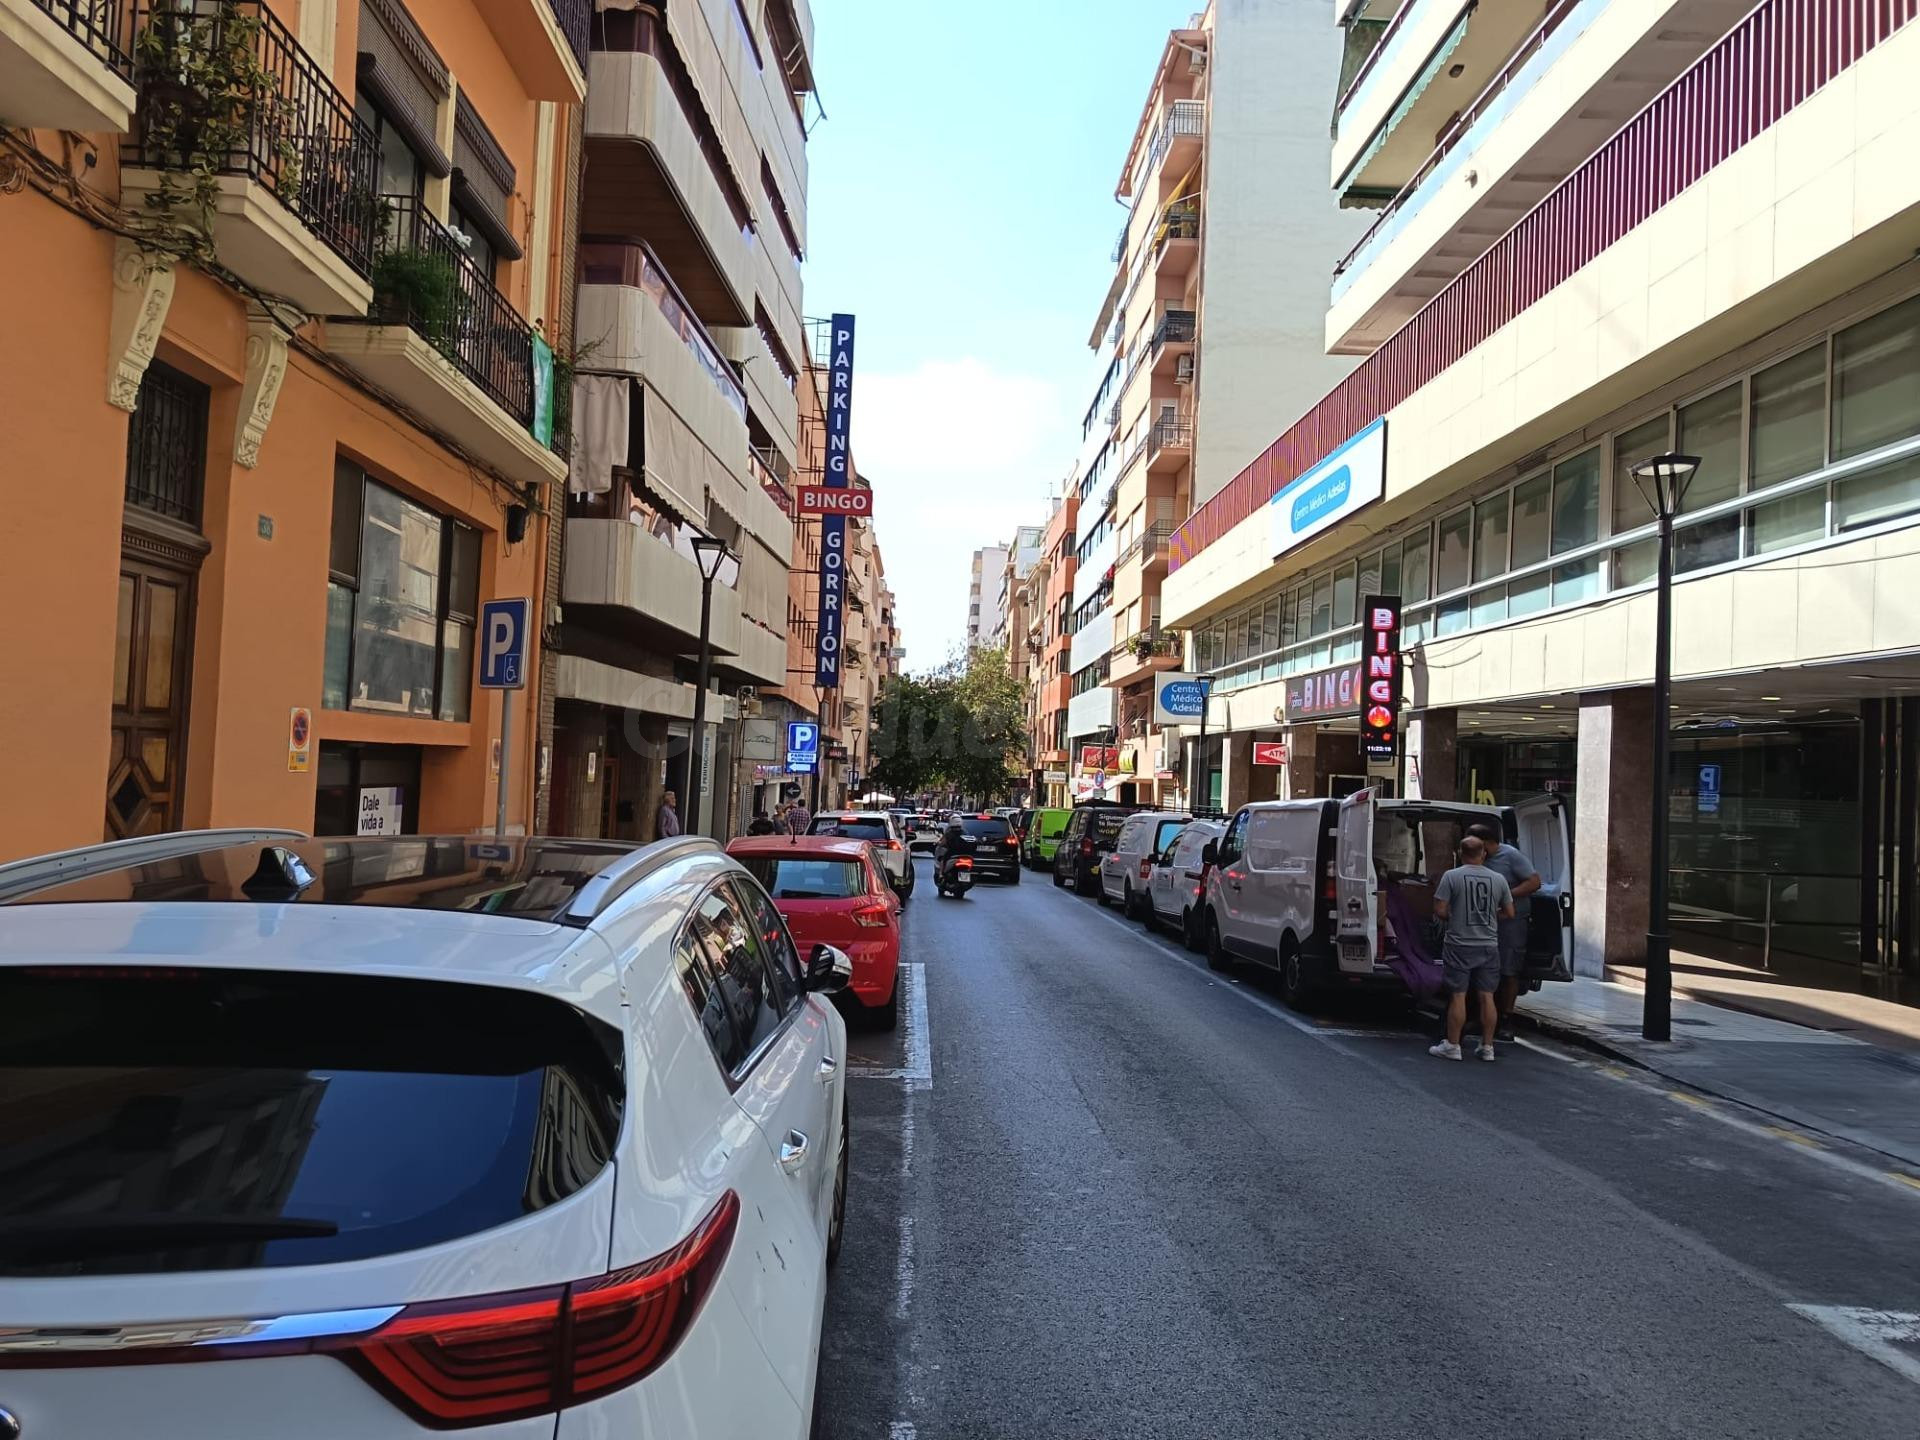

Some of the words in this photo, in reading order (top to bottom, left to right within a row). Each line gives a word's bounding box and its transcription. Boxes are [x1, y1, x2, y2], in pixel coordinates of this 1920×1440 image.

[830, 329, 850, 472] PARKING
[803, 491, 867, 510] BINGO
[821, 531, 841, 673] GORRIÓN
[487, 612, 515, 678] P
[1170, 694, 1203, 703] Médico
[795, 726, 813, 750] P
[1269, 750, 1286, 758] ATM
[362, 794, 380, 811] Dale
[361, 813, 377, 830] vida
[378, 817, 384, 829] a
[1470, 881, 1489, 913] IG
